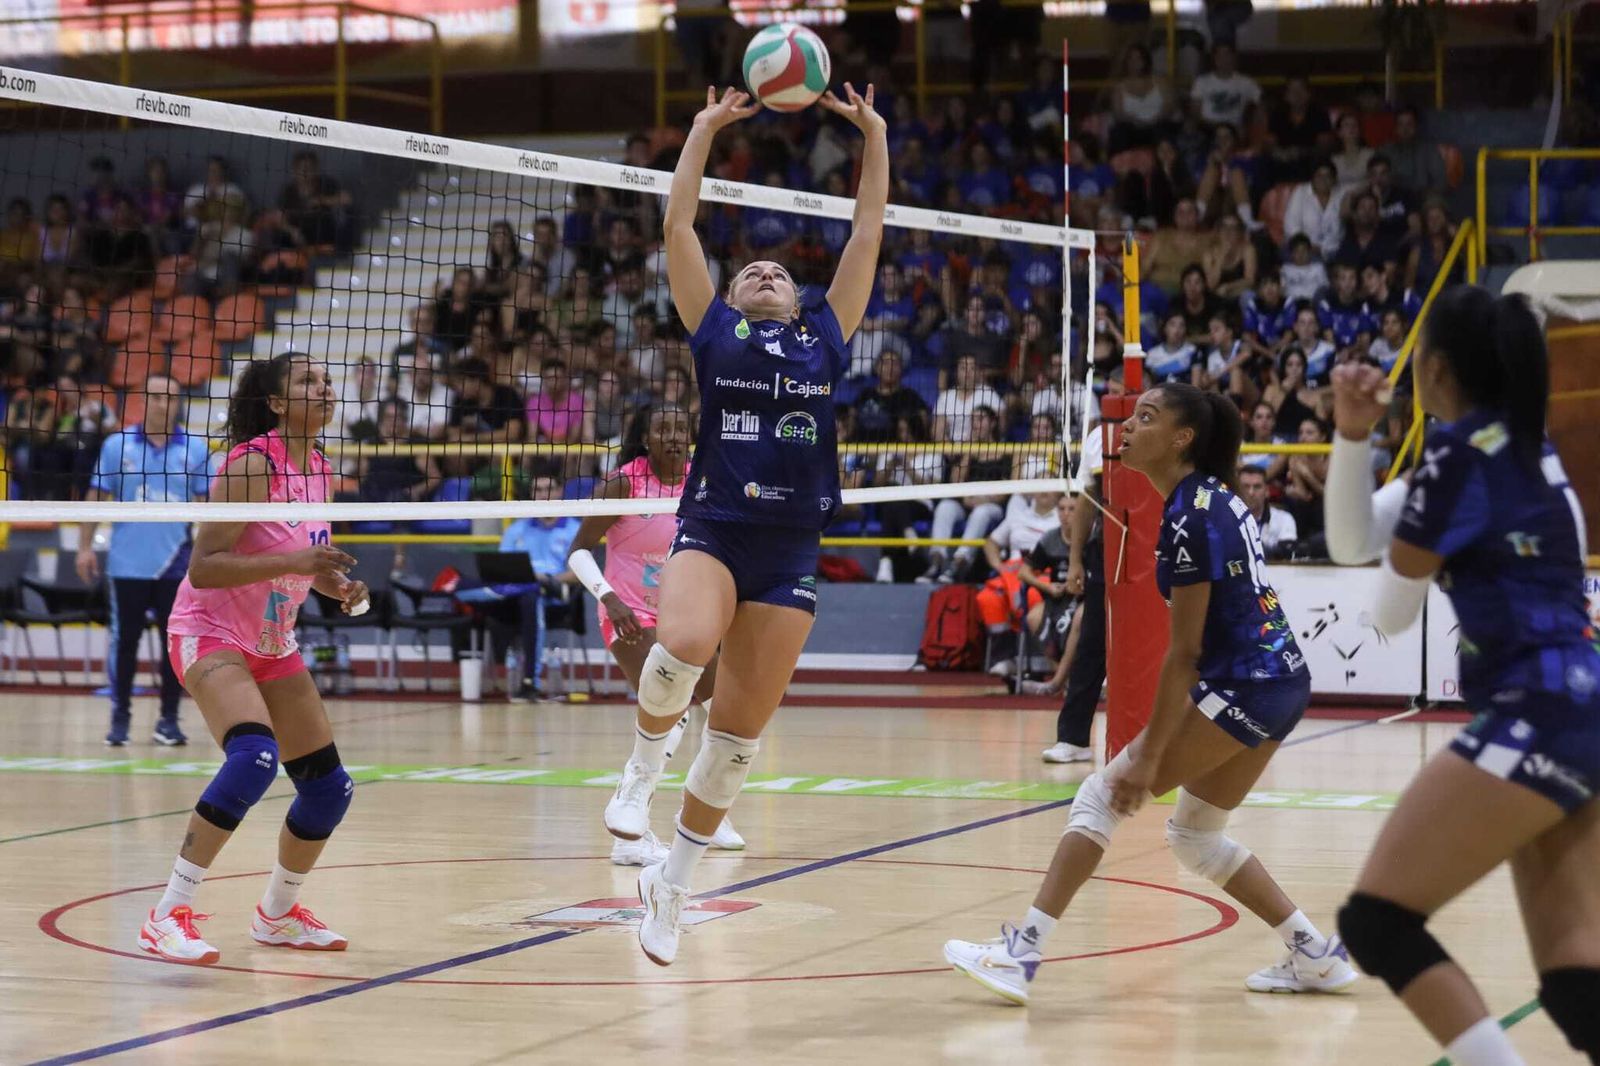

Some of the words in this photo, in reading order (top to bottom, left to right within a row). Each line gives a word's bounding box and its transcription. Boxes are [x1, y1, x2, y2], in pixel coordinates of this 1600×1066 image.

[136, 93, 191, 118] rfevb.com
[279, 115, 328, 138] rfevb.com
[405, 135, 450, 156] rfevb.com
[518, 152, 558, 172] rfevb.com
[619, 168, 655, 186] rfevb.com
[715, 376, 770, 391] Fundación
[721, 408, 760, 433] berlin
